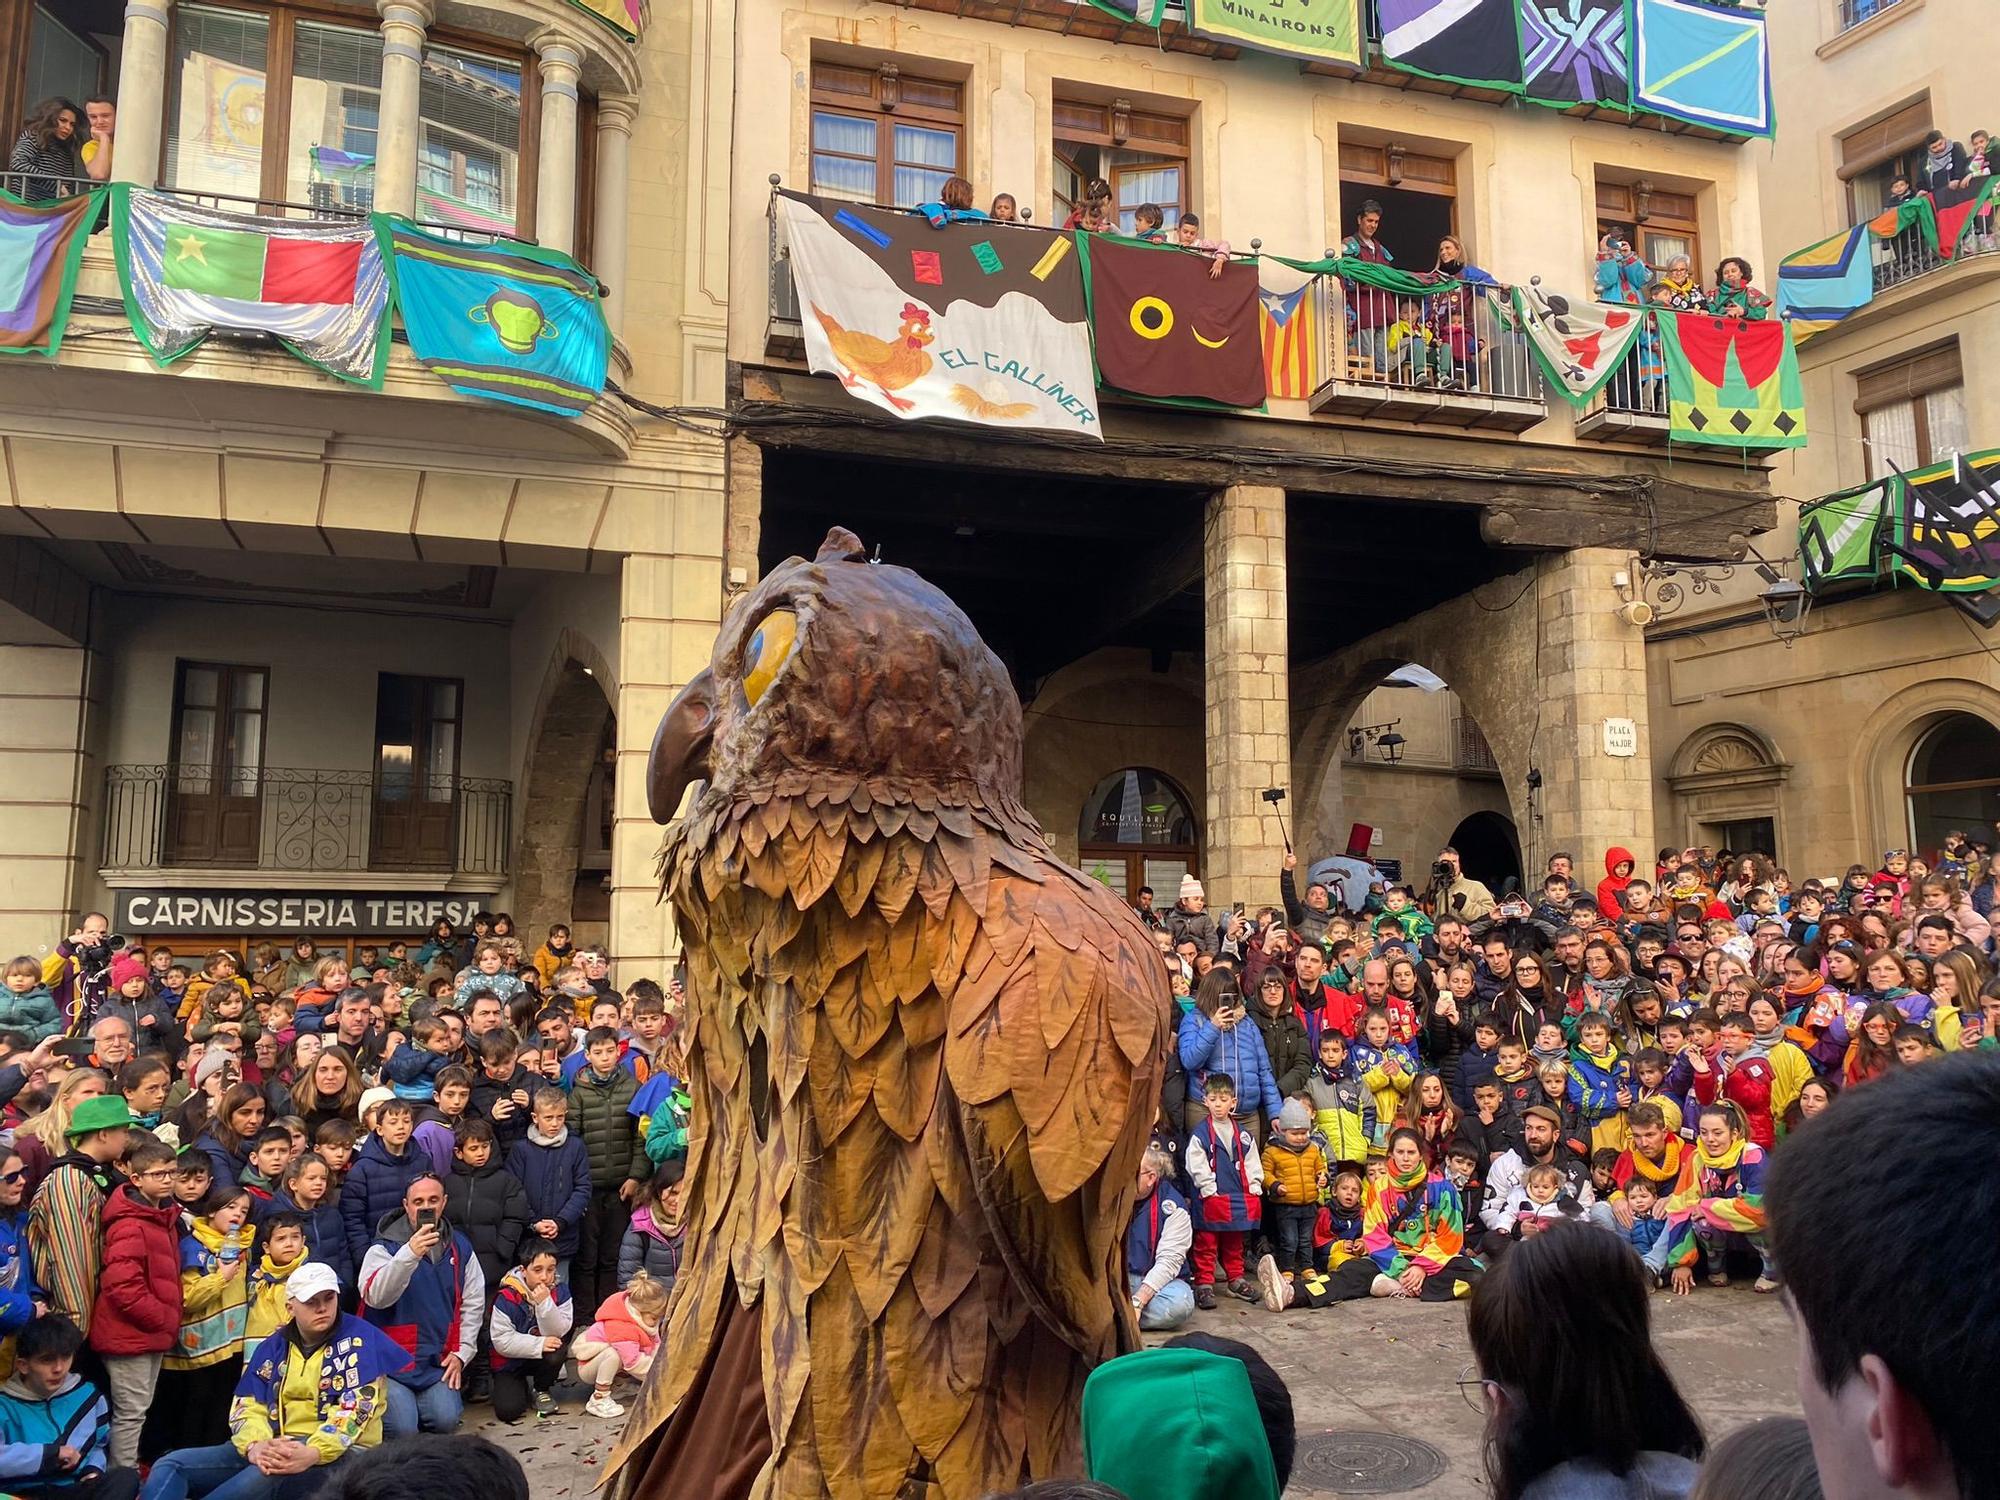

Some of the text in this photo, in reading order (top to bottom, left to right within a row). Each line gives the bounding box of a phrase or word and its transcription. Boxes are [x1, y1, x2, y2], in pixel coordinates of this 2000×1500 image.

[1222, 0, 1336, 38] MINAIRONS
[939, 348, 979, 369] EL
[1610, 739, 1632, 748] MAJOR
[1101, 813, 1165, 822] EQUILIBRI
[128, 897, 480, 927] CARNISSERIA TERESA
